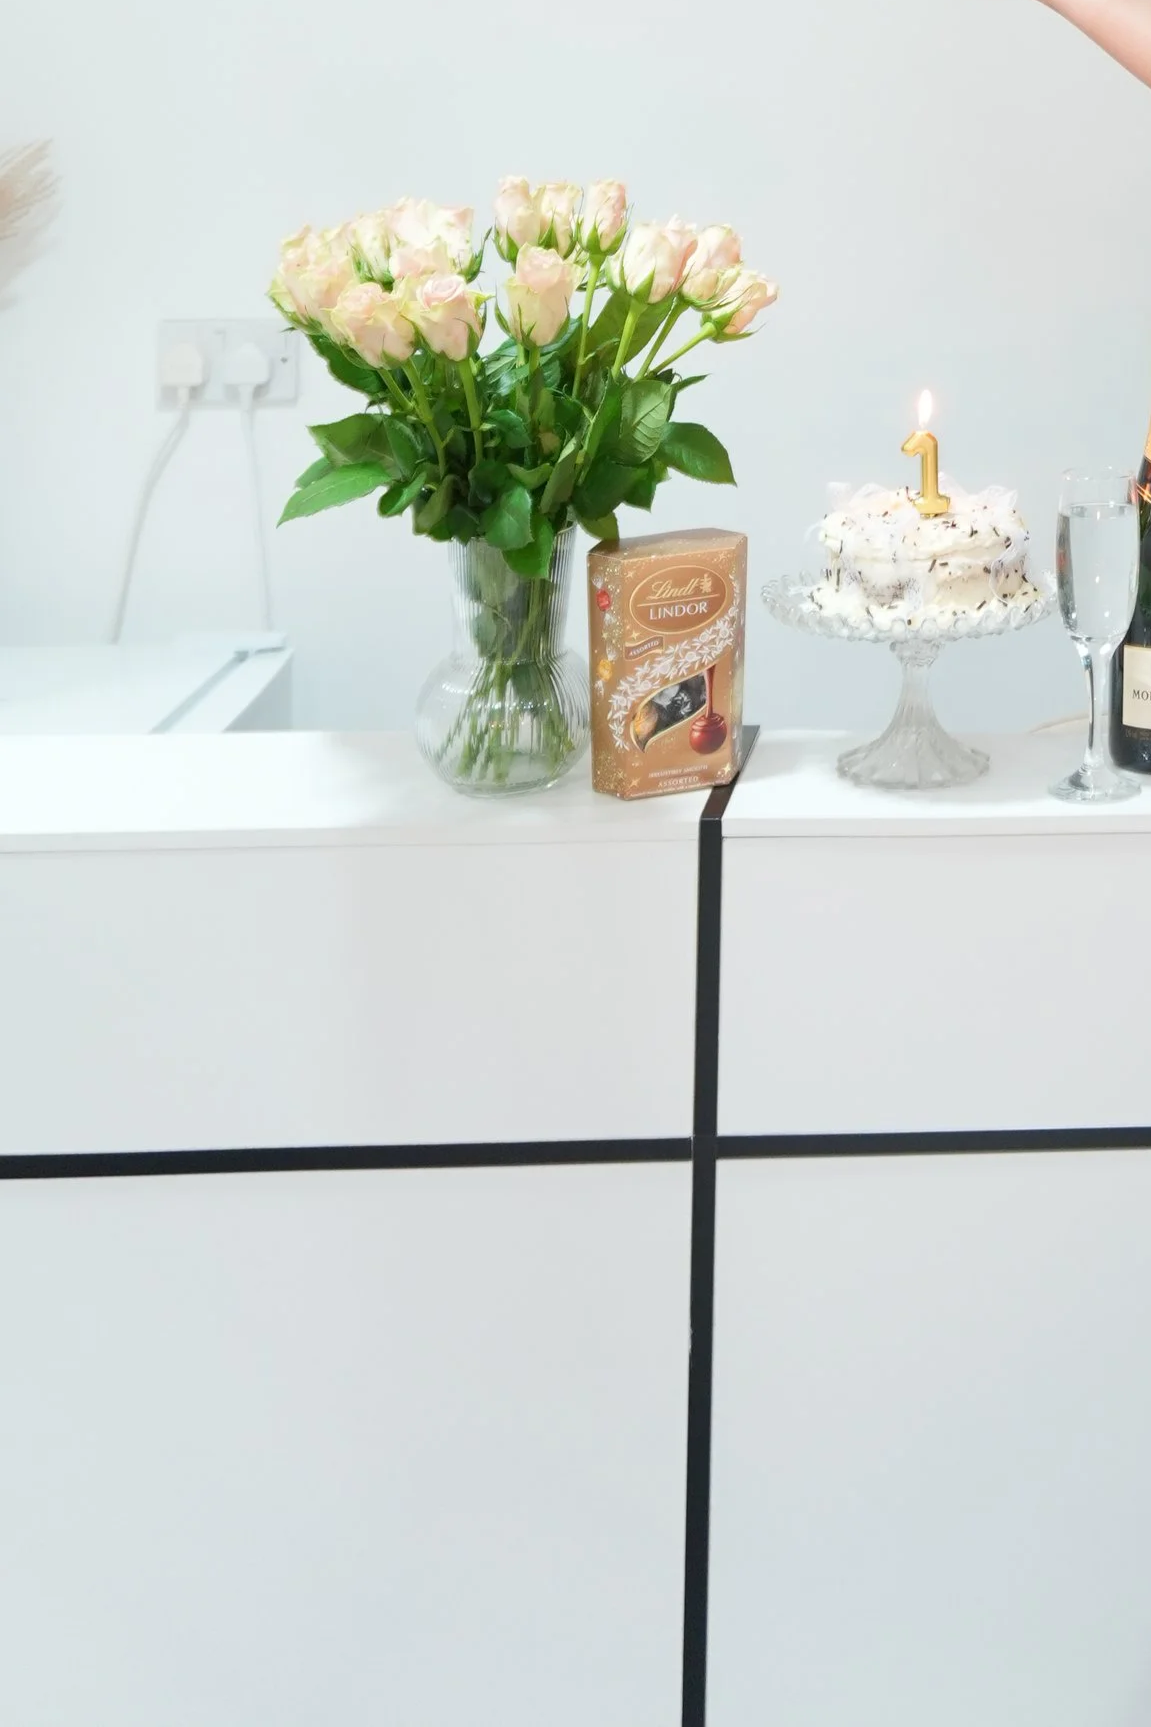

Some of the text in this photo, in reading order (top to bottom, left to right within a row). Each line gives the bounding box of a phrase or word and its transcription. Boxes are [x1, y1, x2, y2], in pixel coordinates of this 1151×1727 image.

[646, 577, 700, 600] Lindt
[649, 601, 708, 620] LINDOR
[657, 776, 699, 788] ASSORTED
